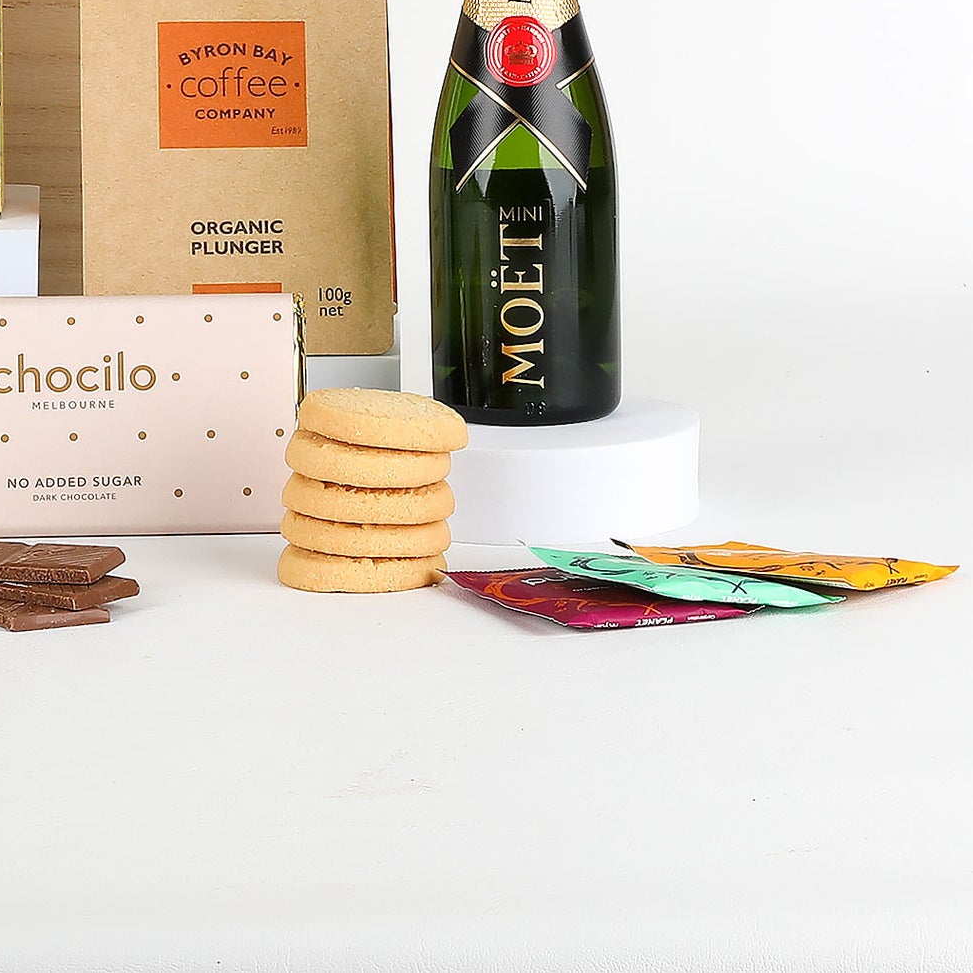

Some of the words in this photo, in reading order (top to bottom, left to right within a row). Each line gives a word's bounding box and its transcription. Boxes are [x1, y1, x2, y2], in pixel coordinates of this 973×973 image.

[178, 43, 246, 66] BYRON
[253, 44, 293, 66] BAY
[180, 66, 287, 98] coffee
[195, 108, 276, 120] COMPANY
[499, 205, 543, 222] MINI
[191, 220, 284, 235] ORGANIC
[191, 240, 284, 255] PLUNGER
[318, 287, 352, 305] 100g
[319, 305, 343, 316] net
[490, 223, 545, 389] MOËT
[32, 399, 115, 411] MELBOURNE
[7, 477, 29, 489] NO
[34, 476, 87, 488] ADDED
[92, 475, 143, 487] SUGAR
[33, 493, 58, 502] DARK
[60, 491, 117, 502] CHOCOLATE
[635, 616, 674, 628] PLANET
